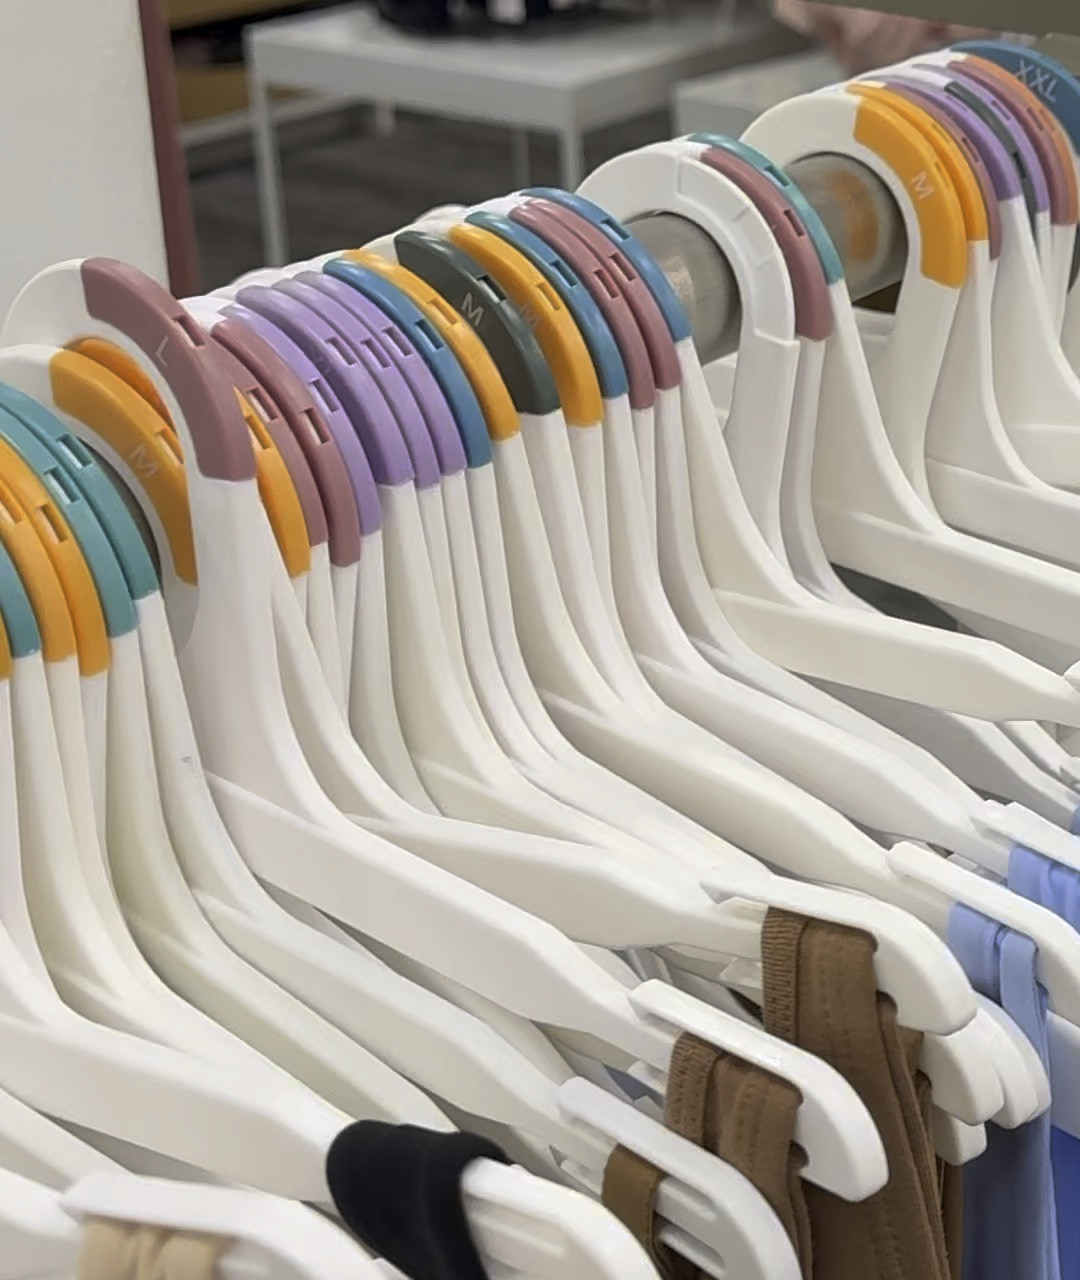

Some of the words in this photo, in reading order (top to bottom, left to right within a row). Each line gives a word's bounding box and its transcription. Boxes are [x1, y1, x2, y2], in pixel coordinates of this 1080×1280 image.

[1015, 59, 1059, 103] XXL
[911, 170, 935, 201] M
[460, 291, 485, 327] M
[156, 337, 169, 366] L
[130, 444, 160, 479] M
